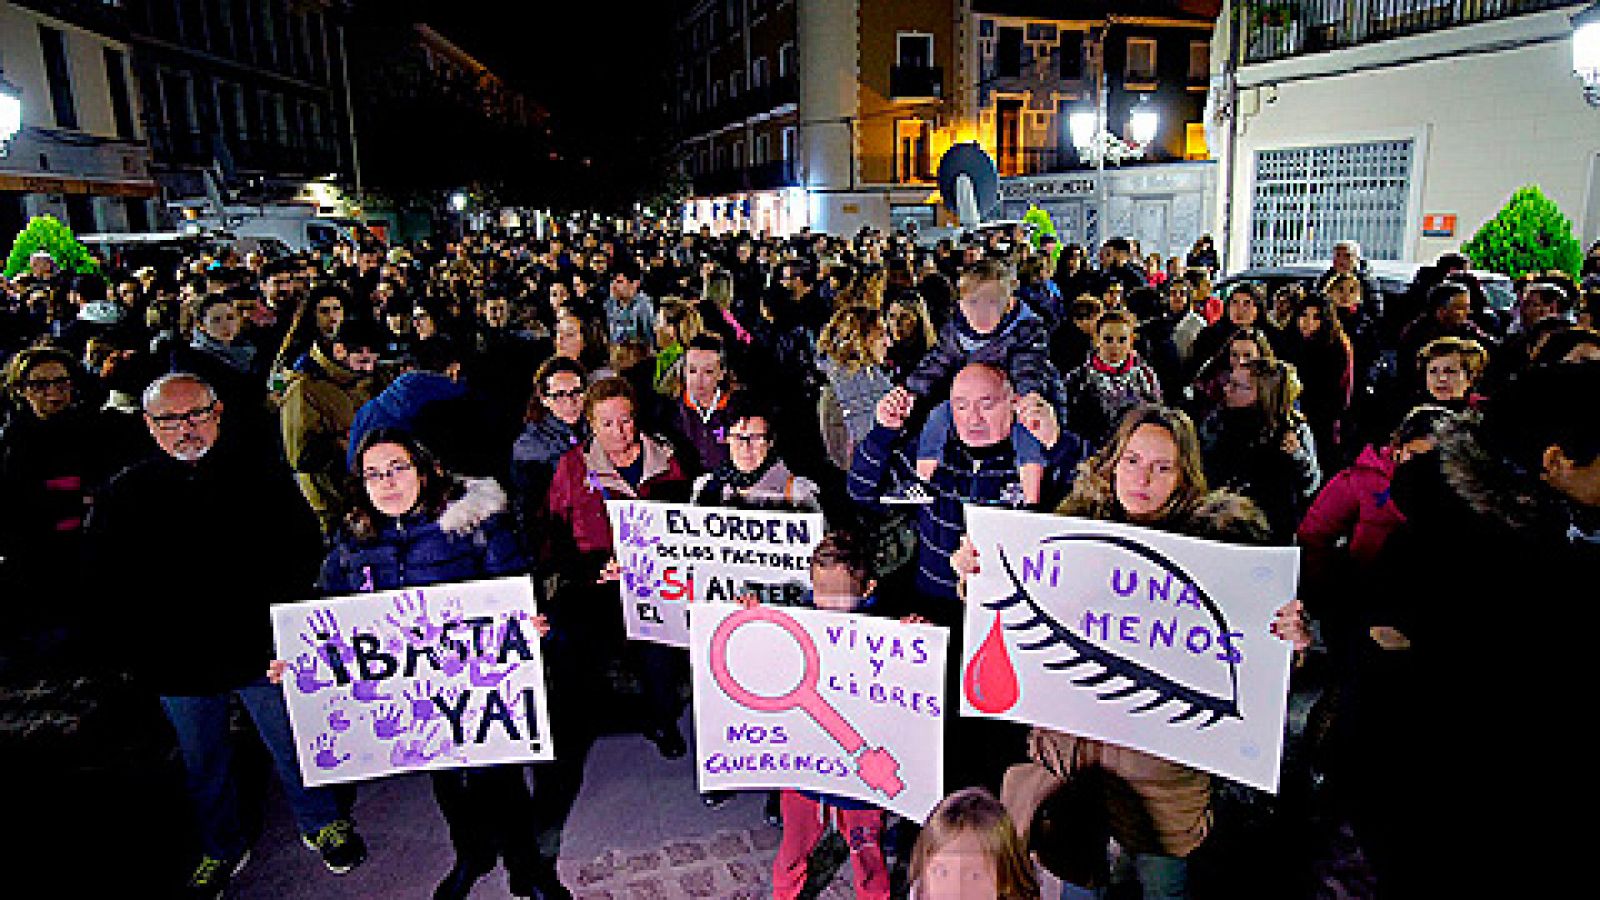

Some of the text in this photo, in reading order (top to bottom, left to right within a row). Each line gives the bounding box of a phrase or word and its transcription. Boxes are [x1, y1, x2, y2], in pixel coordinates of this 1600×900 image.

[666, 509, 810, 543] EL ORDEN
[656, 543, 677, 557] DE
[683, 546, 713, 560] LOS
[1112, 566, 1201, 610] UNA
[316, 616, 534, 687] ¡BASTA
[1083, 609, 1244, 664] MENOS
[430, 688, 541, 754] YA!
[726, 722, 788, 744] NOS
[703, 752, 849, 777] QUEREMOS
